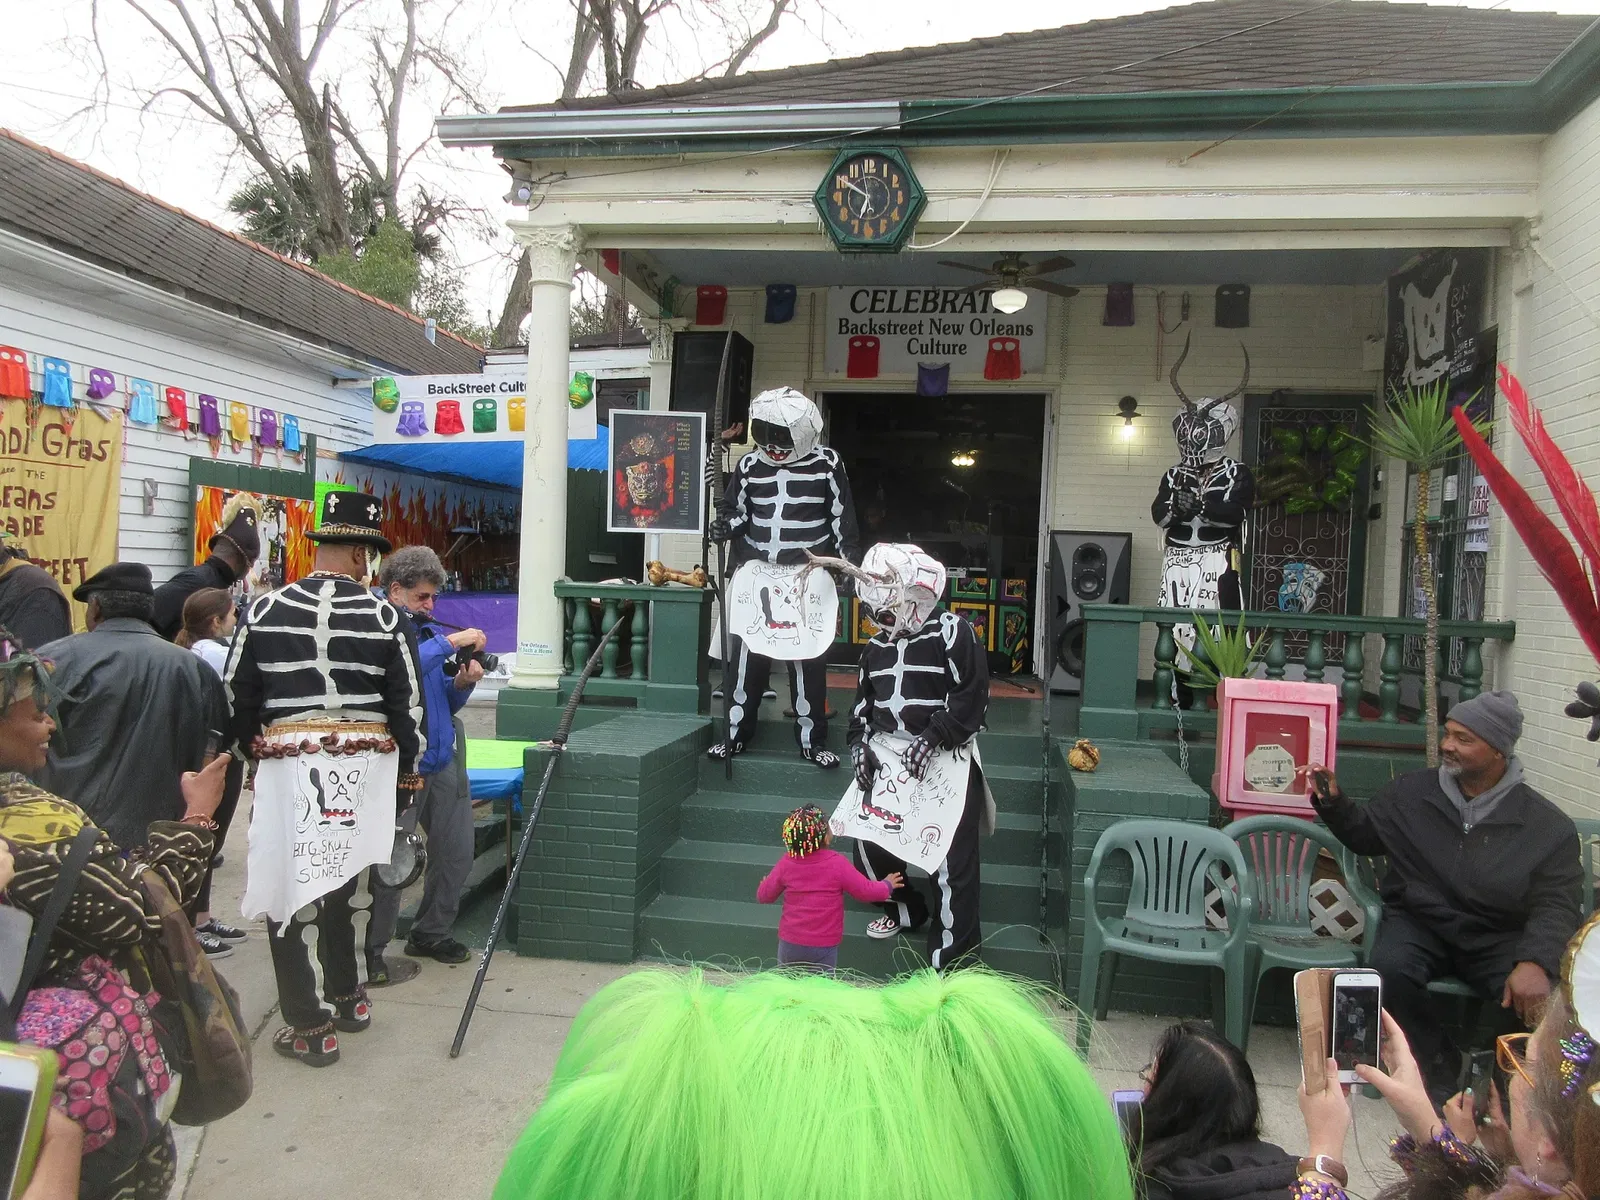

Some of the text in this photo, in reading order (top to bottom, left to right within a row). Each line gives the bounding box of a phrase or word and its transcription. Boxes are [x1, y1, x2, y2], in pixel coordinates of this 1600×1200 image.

[850, 289, 1004, 314] CELEBRAT
[838, 317, 1034, 336] Backstreet New Orleans
[907, 338, 968, 356] Culture
[428, 381, 526, 394] BackStreet Cult
[42, 423, 110, 462] Gras
[0, 486, 57, 510] Eans
[28, 557, 88, 584] EET
[293, 838, 352, 858] BIG SKULL
[310, 852, 350, 866] CHIEF
[296, 864, 344, 884] SUNPIE
